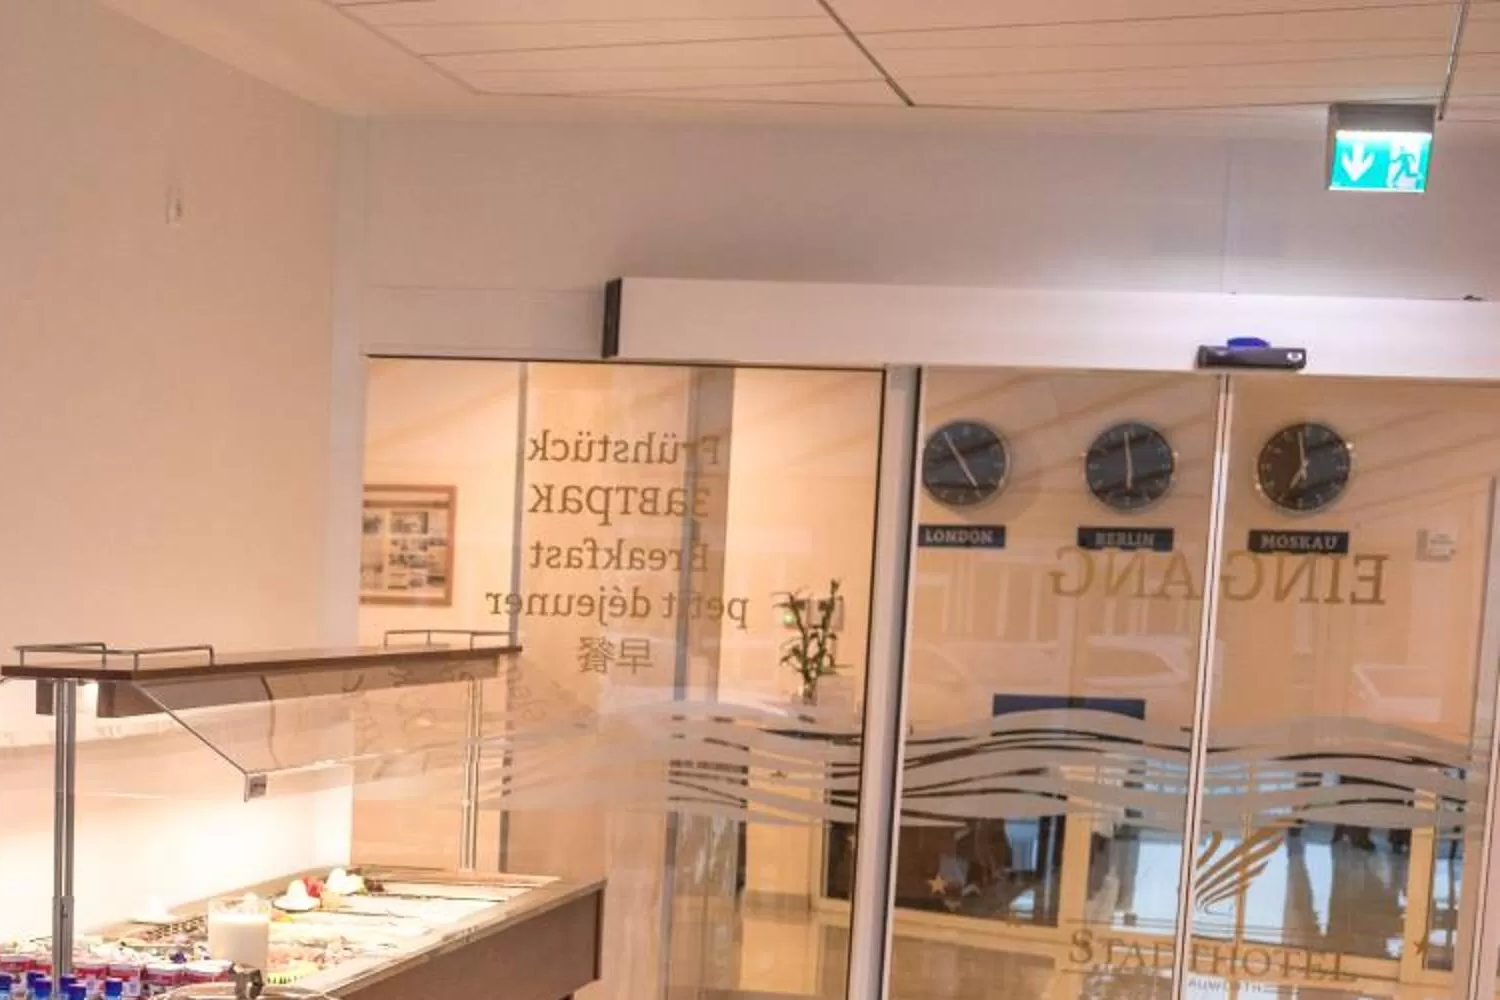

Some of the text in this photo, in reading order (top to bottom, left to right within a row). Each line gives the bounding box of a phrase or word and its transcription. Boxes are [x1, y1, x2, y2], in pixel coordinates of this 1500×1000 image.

[925, 529, 994, 543] LONDON
[1095, 532, 1155, 546] BERLIN
[1260, 534, 1338, 550] MOSKAU
